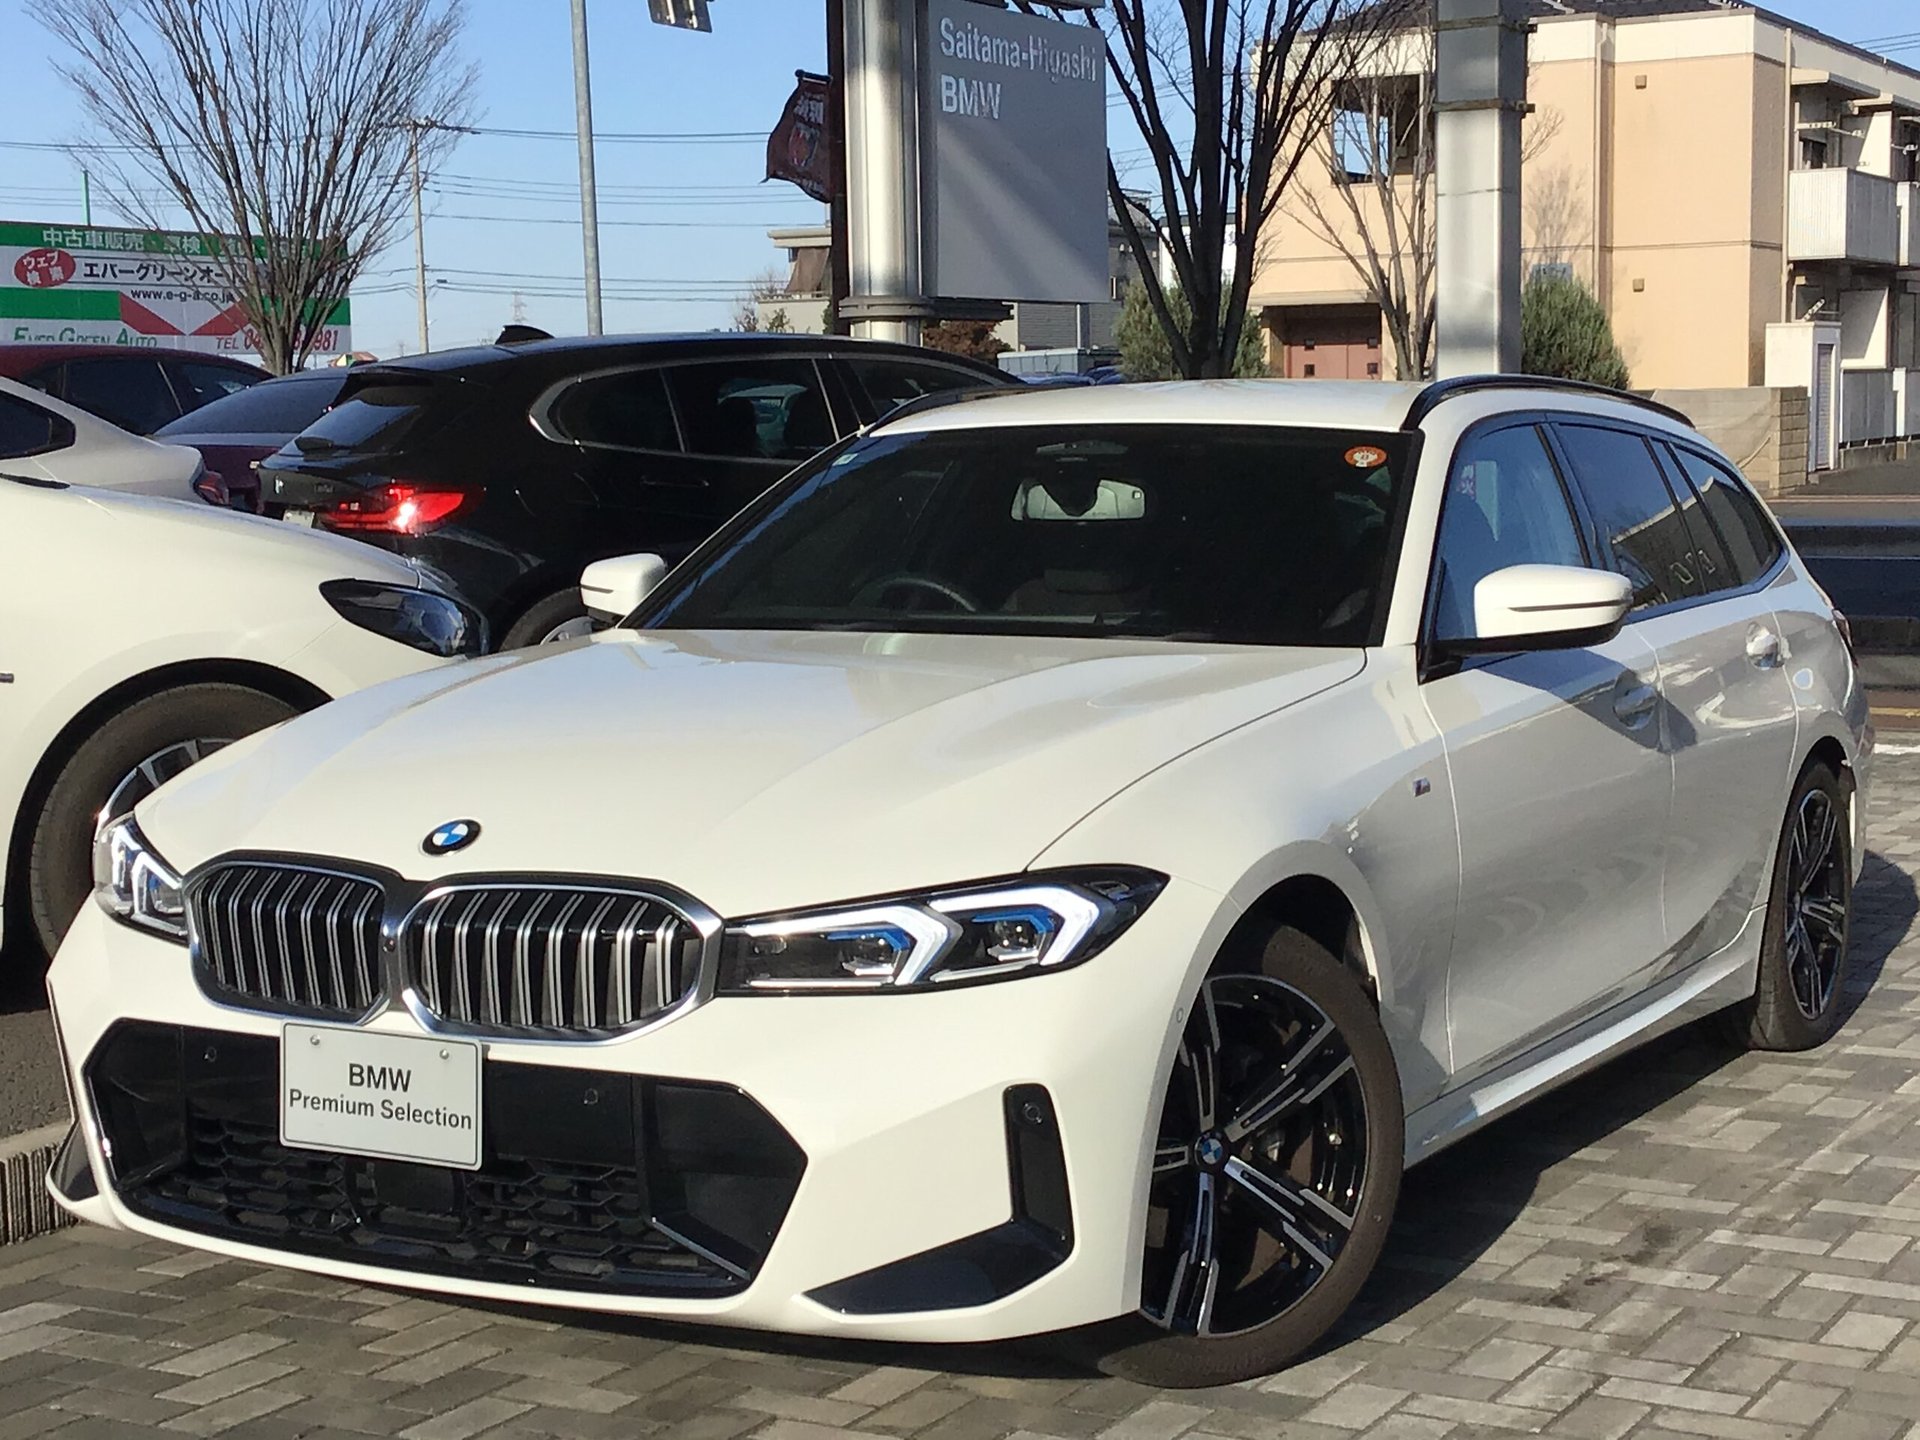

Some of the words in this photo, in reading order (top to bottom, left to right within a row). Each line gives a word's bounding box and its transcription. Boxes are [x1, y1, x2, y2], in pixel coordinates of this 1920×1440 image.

[940, 17, 1096, 83] Saitama-Higashi
[940, 74, 1000, 119] BMW
[217, 337, 239, 350] TEL
[349, 1063, 411, 1092] BMW
[289, 1089, 374, 1117] Premium
[380, 1099, 472, 1130] Selection
